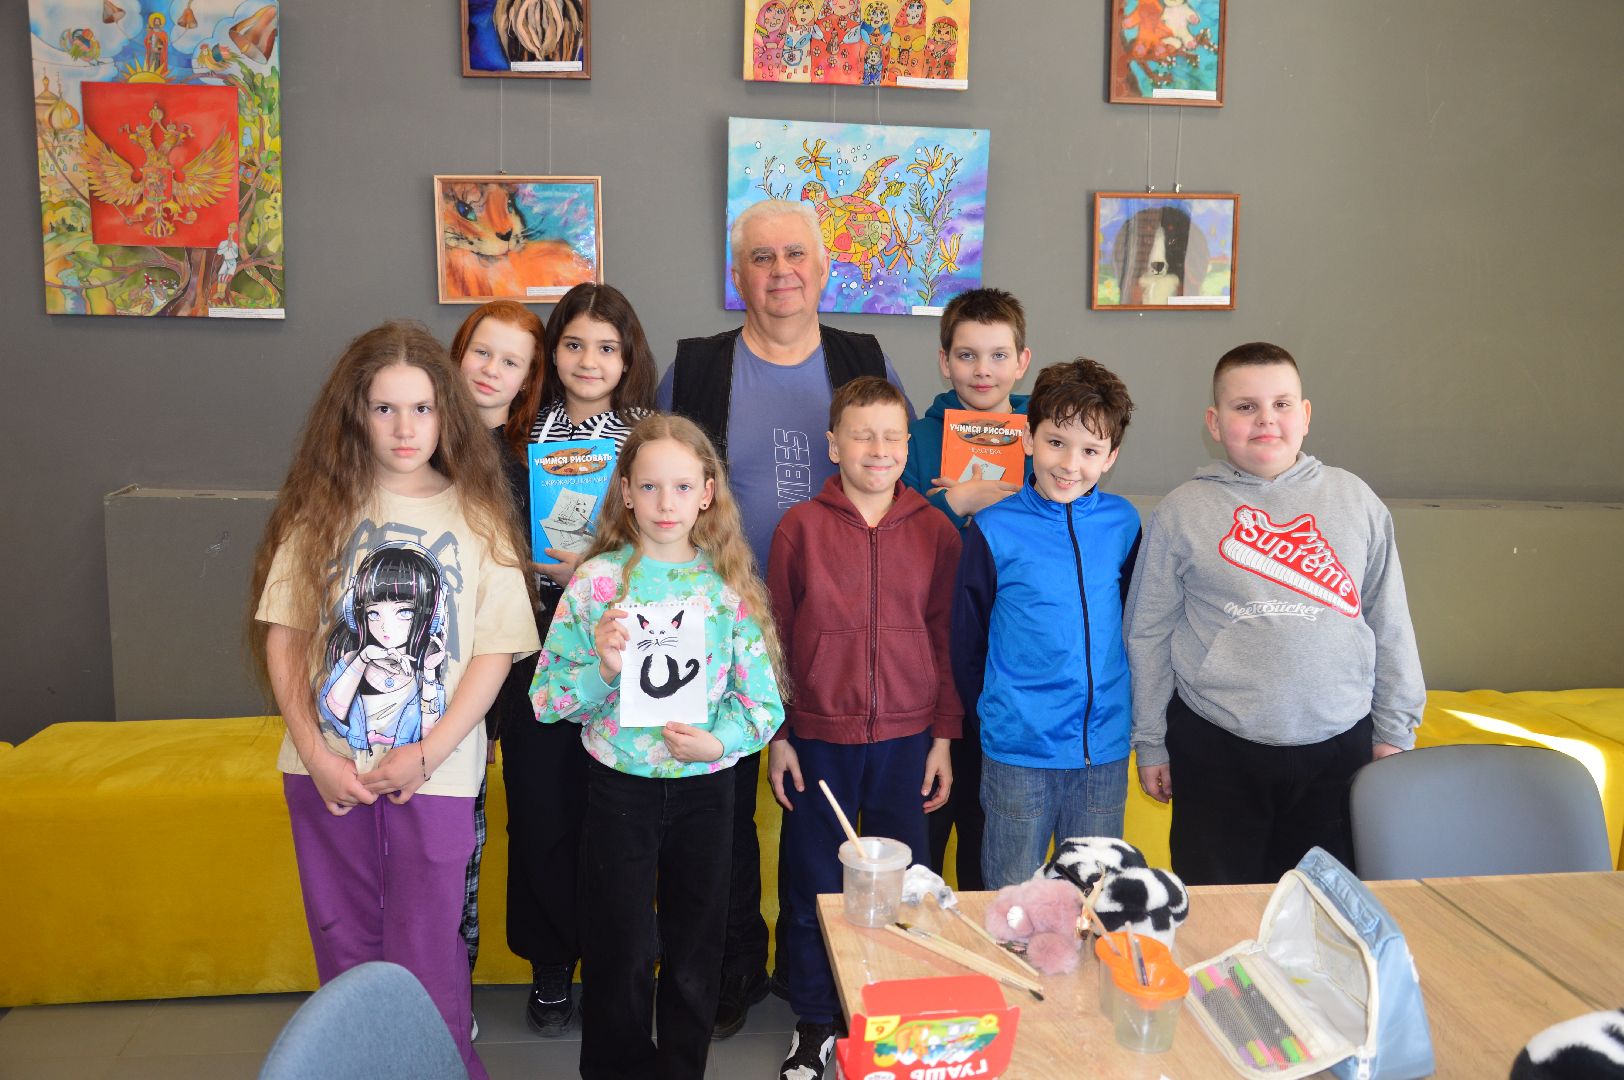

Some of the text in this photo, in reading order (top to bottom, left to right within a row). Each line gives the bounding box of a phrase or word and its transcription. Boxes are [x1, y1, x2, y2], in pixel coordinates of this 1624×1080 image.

[950, 423, 981, 433] УЧИМСЯ
[534, 453, 612, 465] УЧИМСЯ РИСОВАТЬ
[773, 427, 811, 509] VIBES
[1239, 510, 1353, 597] Supreme
[910, 1059, 988, 1080] ГУАШЬ
